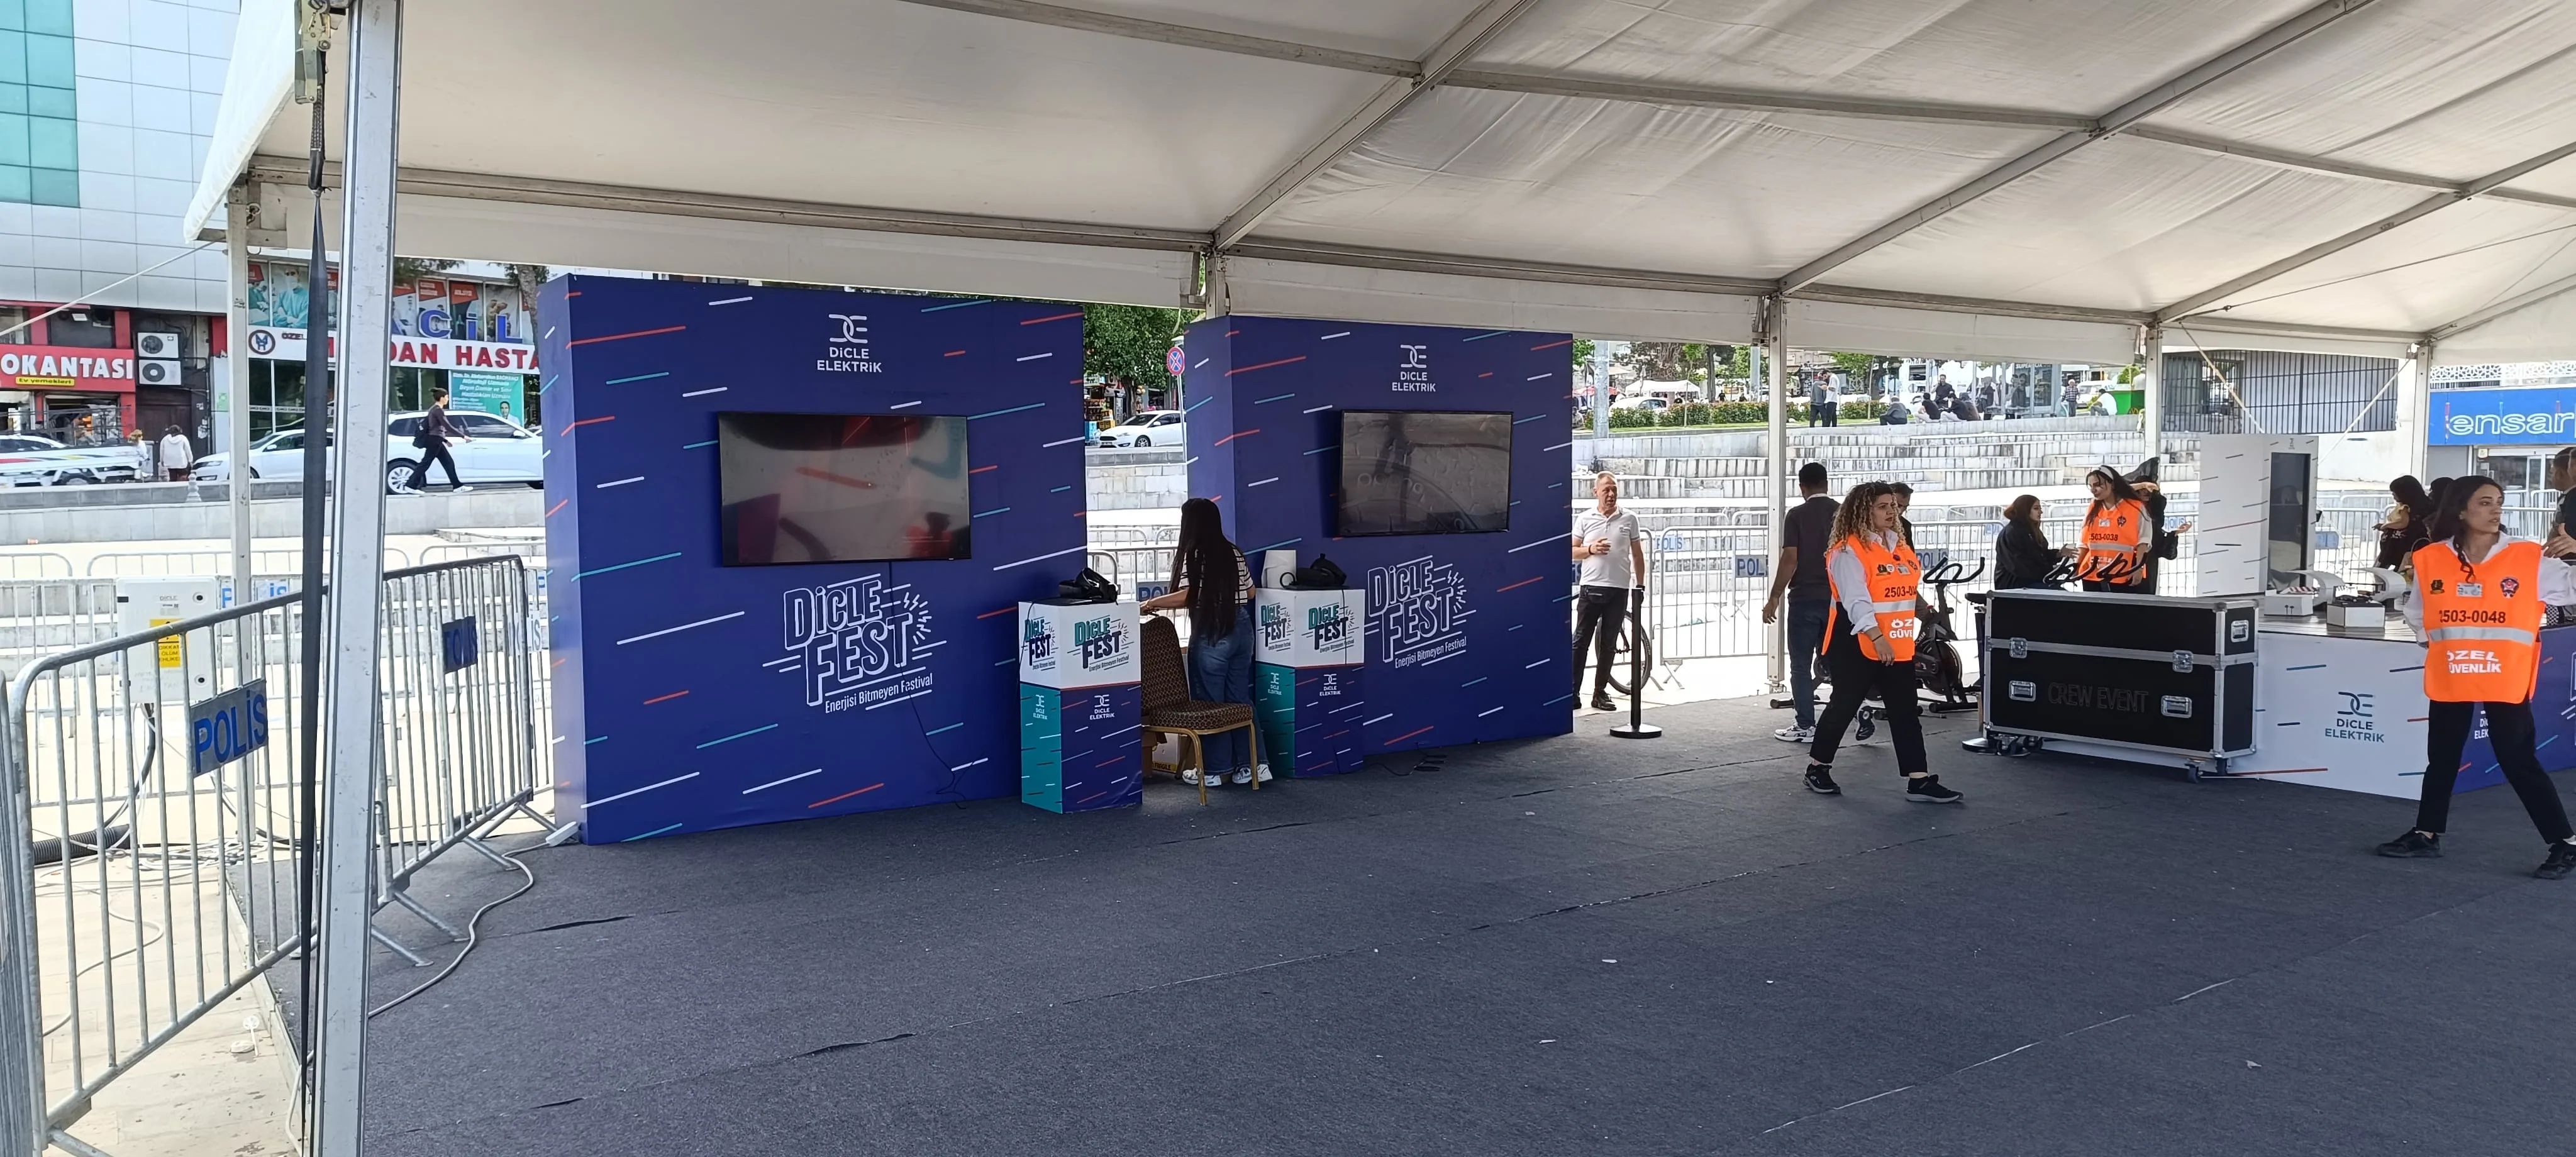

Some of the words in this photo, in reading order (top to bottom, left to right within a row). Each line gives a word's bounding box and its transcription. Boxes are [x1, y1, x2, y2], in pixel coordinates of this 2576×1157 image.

[1265, 617, 1287, 647] FEST
[1314, 616, 1349, 650] FEST
[1382, 587, 1454, 663] FEST
[806, 612, 913, 706] FEST
[1028, 633, 1052, 667] FEST
[1082, 630, 1122, 669] FEST
[1417, 645, 1444, 662] Bitmeyen
[1445, 636, 1467, 653] Festival
[825, 693, 857, 714] Enerjisi
[858, 683, 899, 704] Bitmeyen
[901, 672, 933, 693] Festival
[2048, 682, 2093, 707] CREW
[2097, 687, 2149, 713] EVENT
